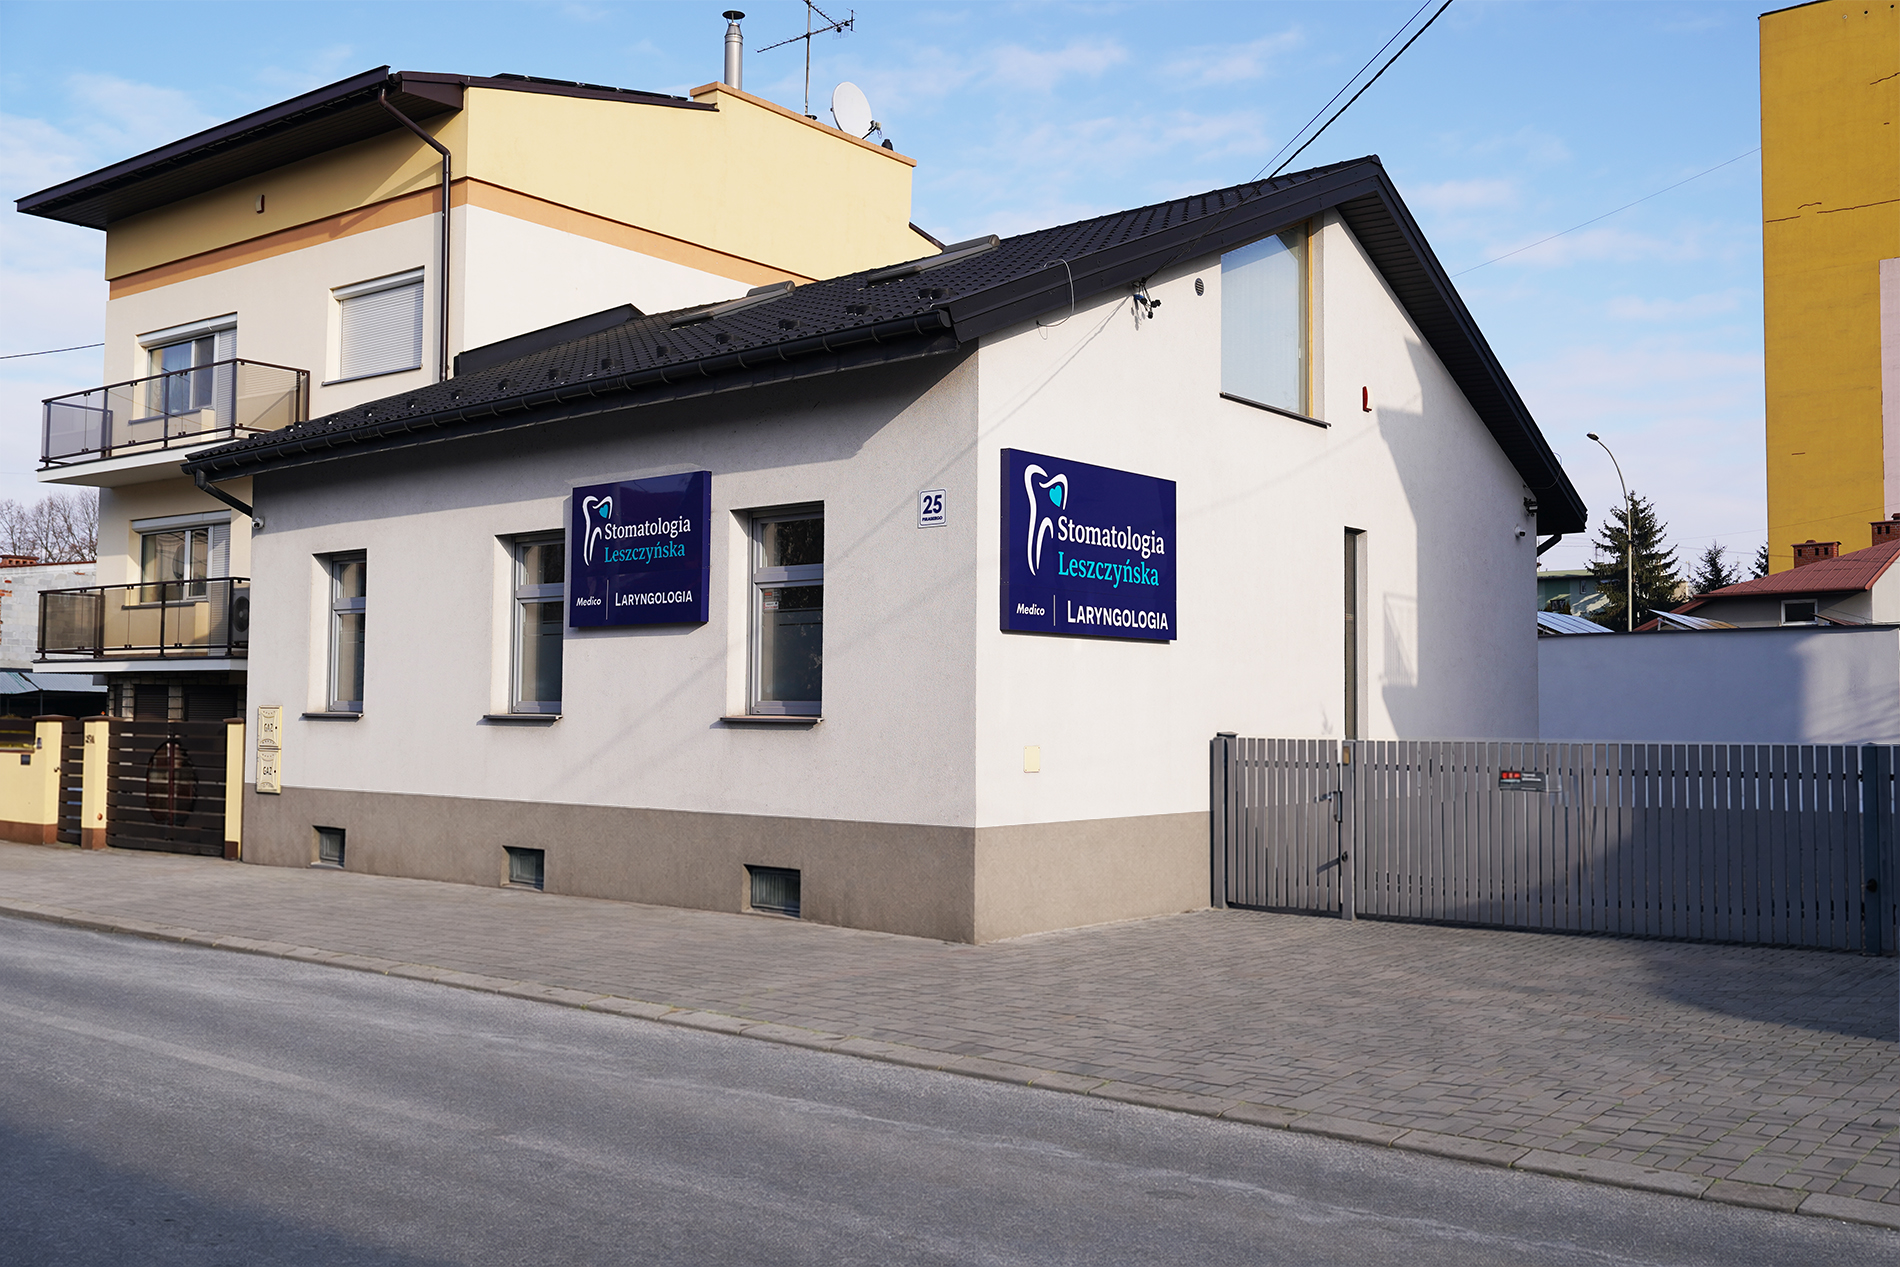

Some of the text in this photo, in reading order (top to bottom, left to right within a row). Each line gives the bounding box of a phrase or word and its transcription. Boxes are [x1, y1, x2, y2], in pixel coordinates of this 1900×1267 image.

[922, 494, 943, 514] 25
[604, 515, 691, 540] Stomatologia
[1057, 515, 1165, 559] Stomatologia
[604, 541, 686, 564] Leszczyńska
[1058, 551, 1160, 588] Leszczyńska
[576, 596, 601, 606] Medico
[615, 590, 693, 606] LARYNGOLOGIA
[1016, 603, 1045, 616] Medico
[1067, 600, 1169, 630] LARYNGOLOGIA
[263, 723, 274, 732] GAZ
[262, 766, 273, 776] GAZ
